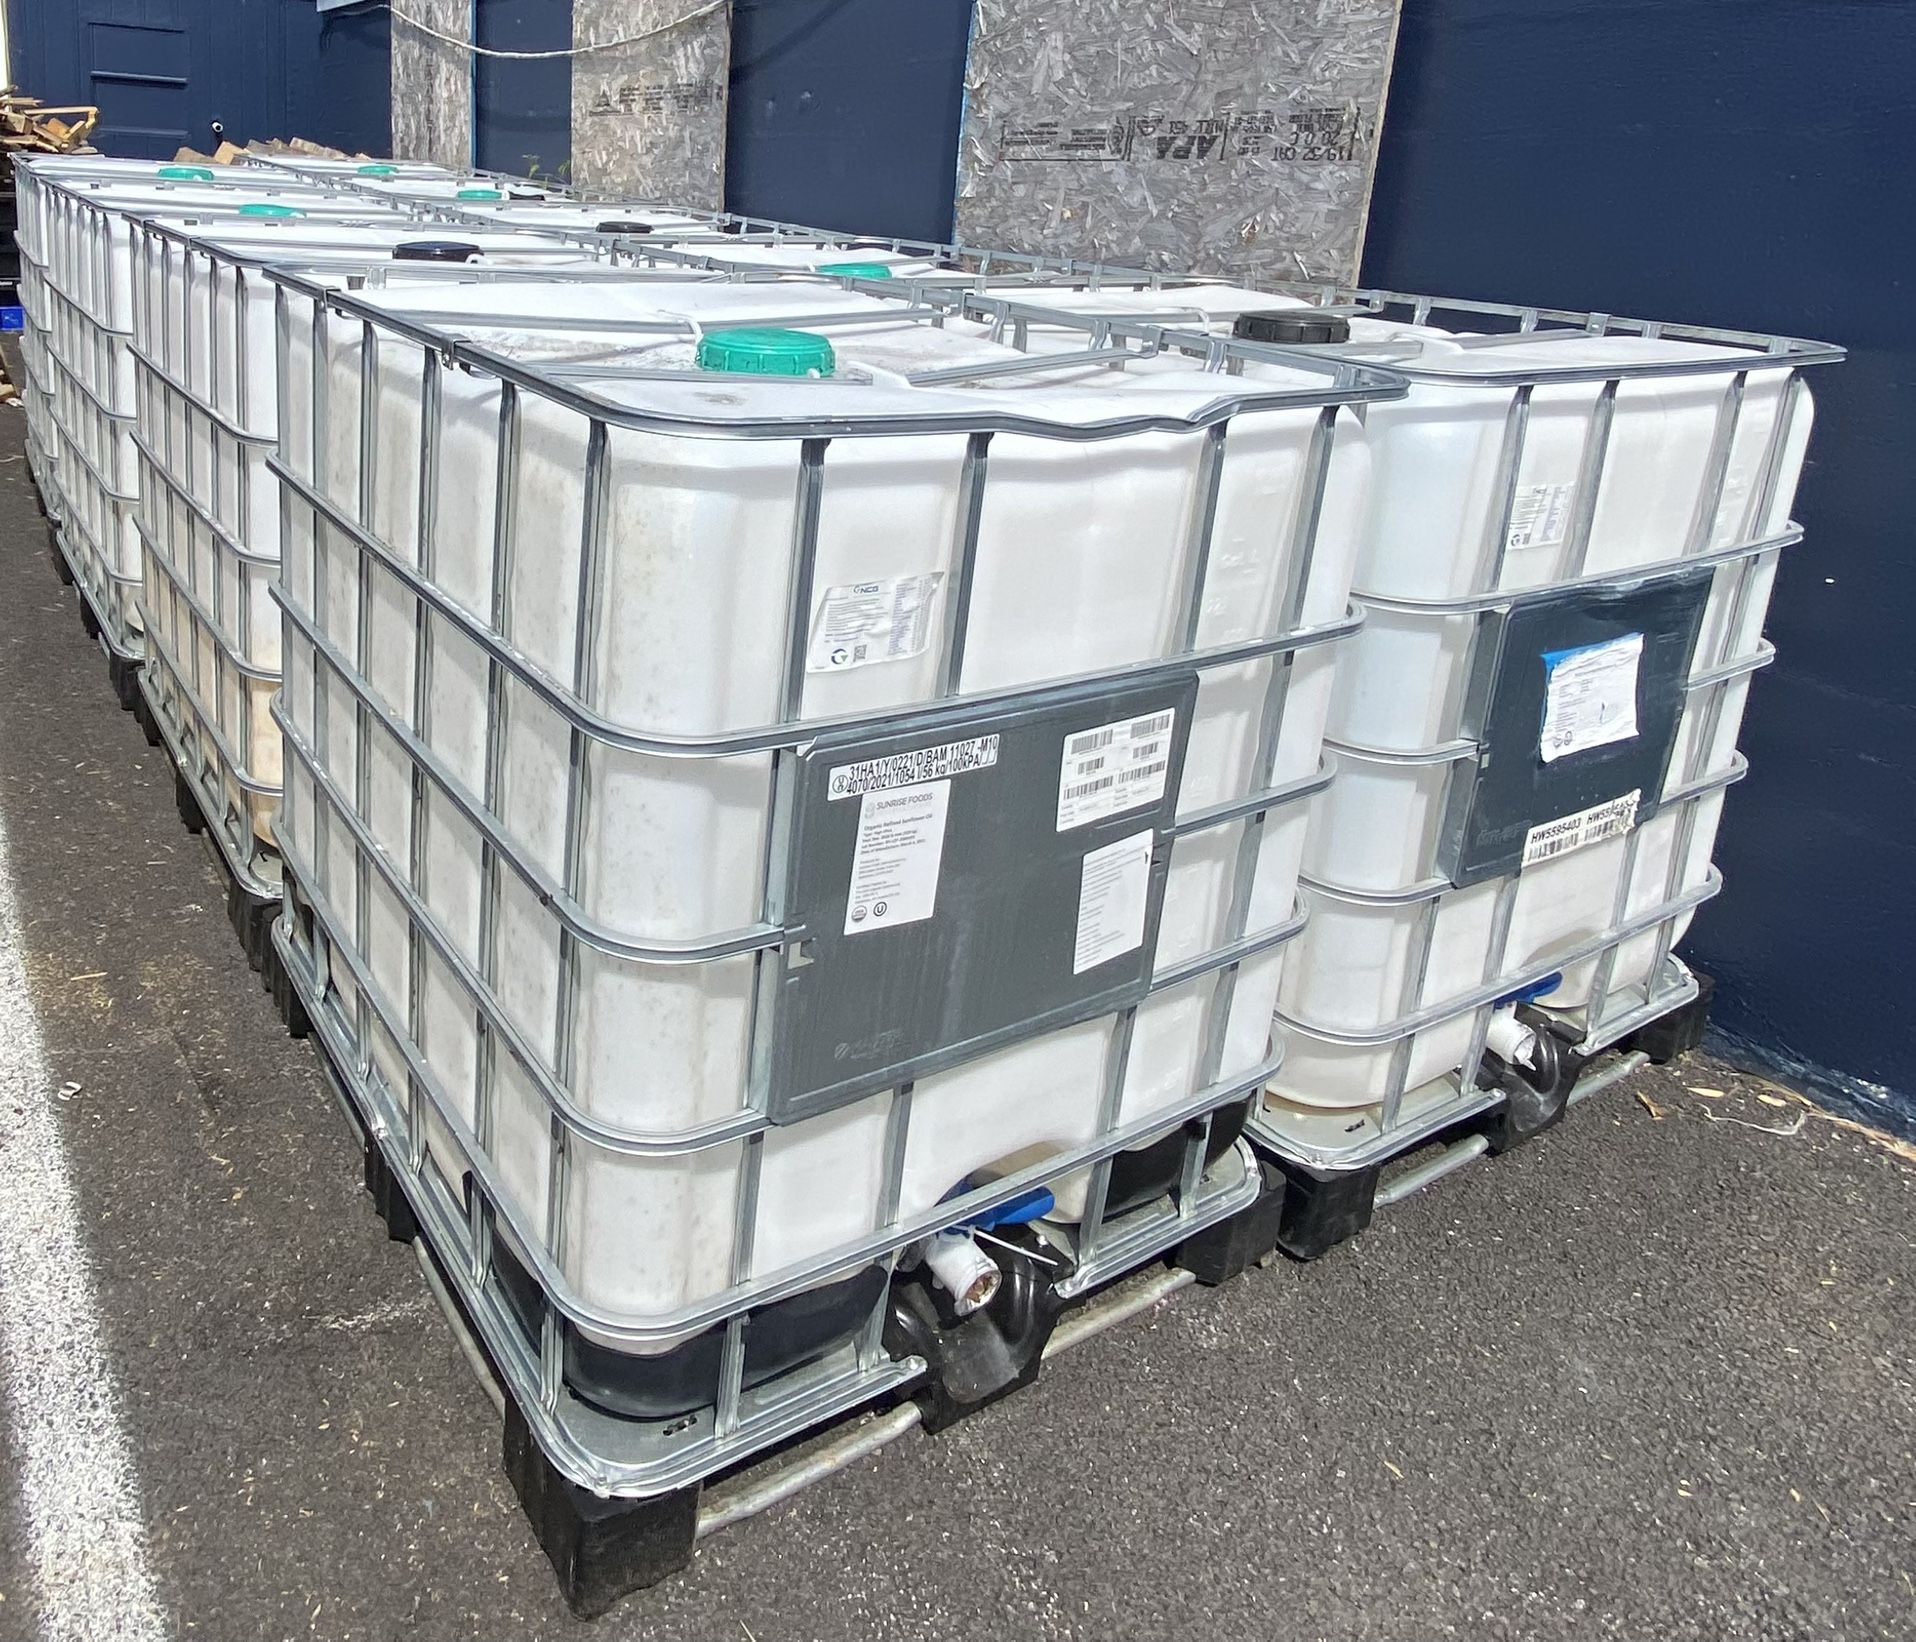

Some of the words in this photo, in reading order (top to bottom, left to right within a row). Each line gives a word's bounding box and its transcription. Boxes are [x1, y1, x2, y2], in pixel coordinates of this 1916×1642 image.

[1155, 135, 1220, 160] APA
[1270, 146, 1297, 162] CAT
[949, 741, 975, 758] 11027
[876, 797, 908, 811] SUNRISE
[908, 792, 934, 804] FOODS
[1530, 817, 1582, 845] HW5595403
